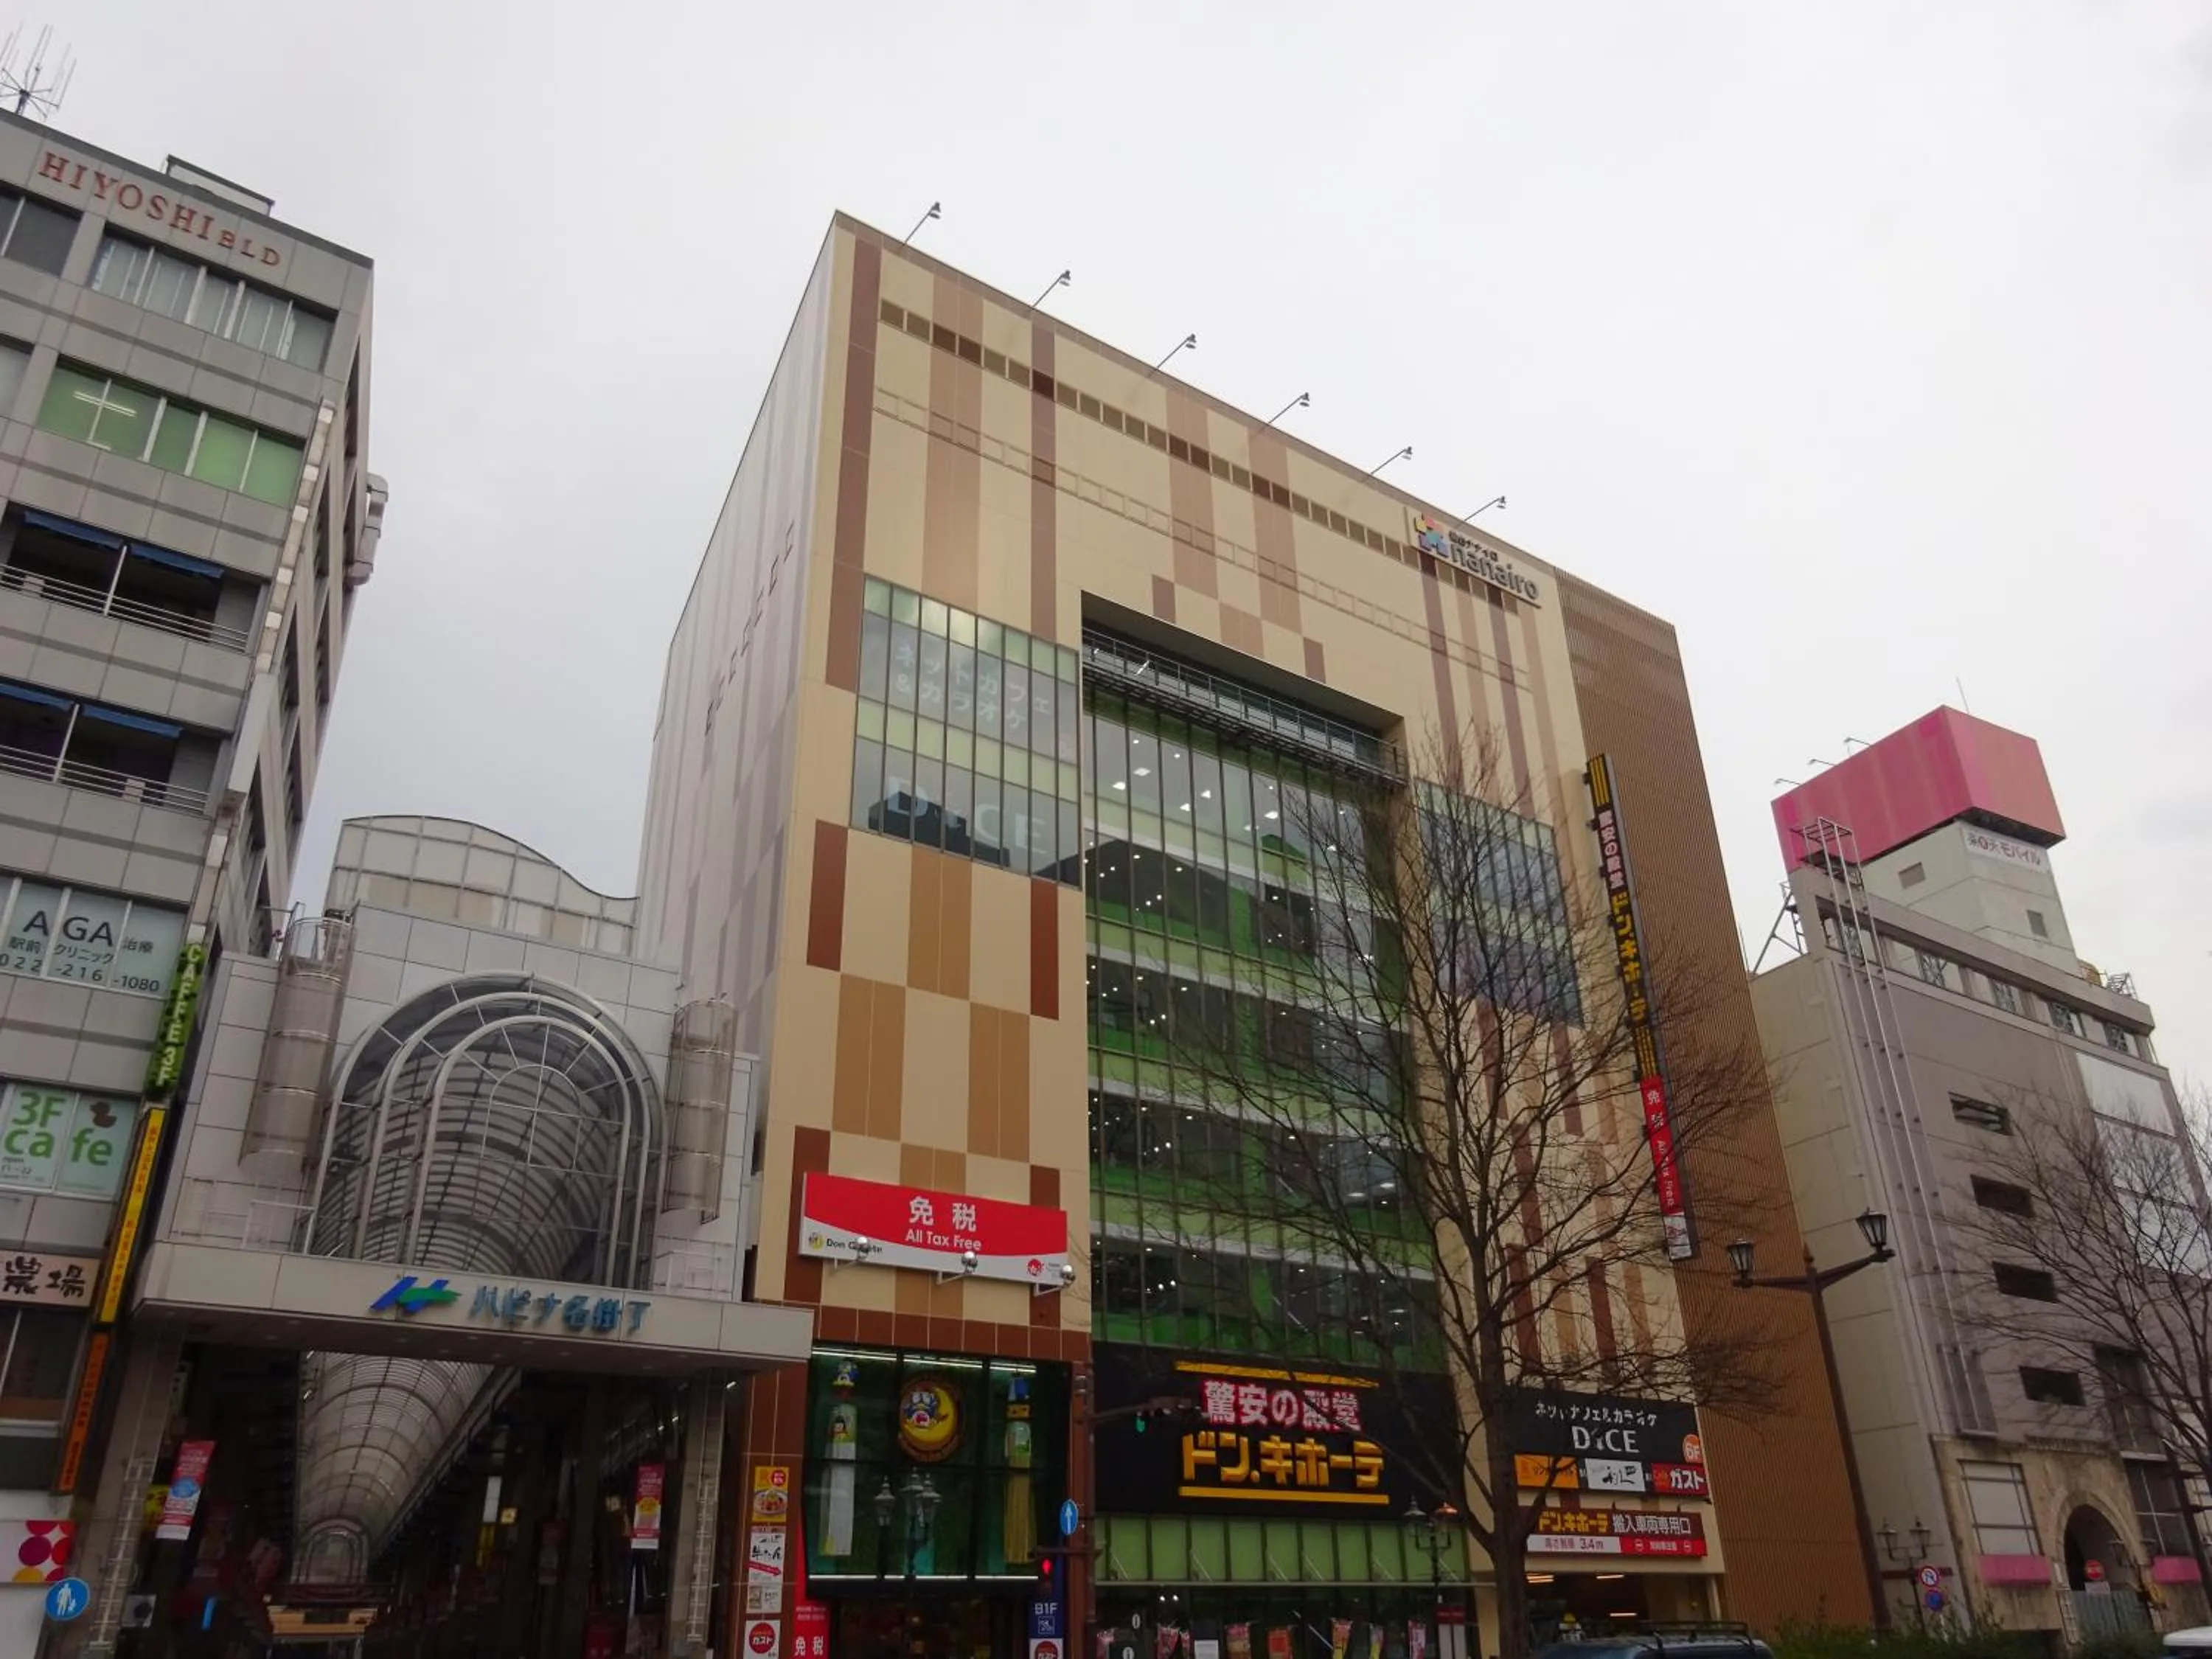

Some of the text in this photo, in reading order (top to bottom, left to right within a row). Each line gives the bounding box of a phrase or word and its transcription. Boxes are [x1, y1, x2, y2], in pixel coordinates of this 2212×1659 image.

[38, 150, 281, 267] HIYOSHI BLD
[23, 910, 113, 947] AGA
[12, 1092, 67, 1128] 3F
[908, 1195, 977, 1232] 免税
[905, 1228, 982, 1252] All Tax Free
[1669, 1468, 1706, 1490] ガスト
